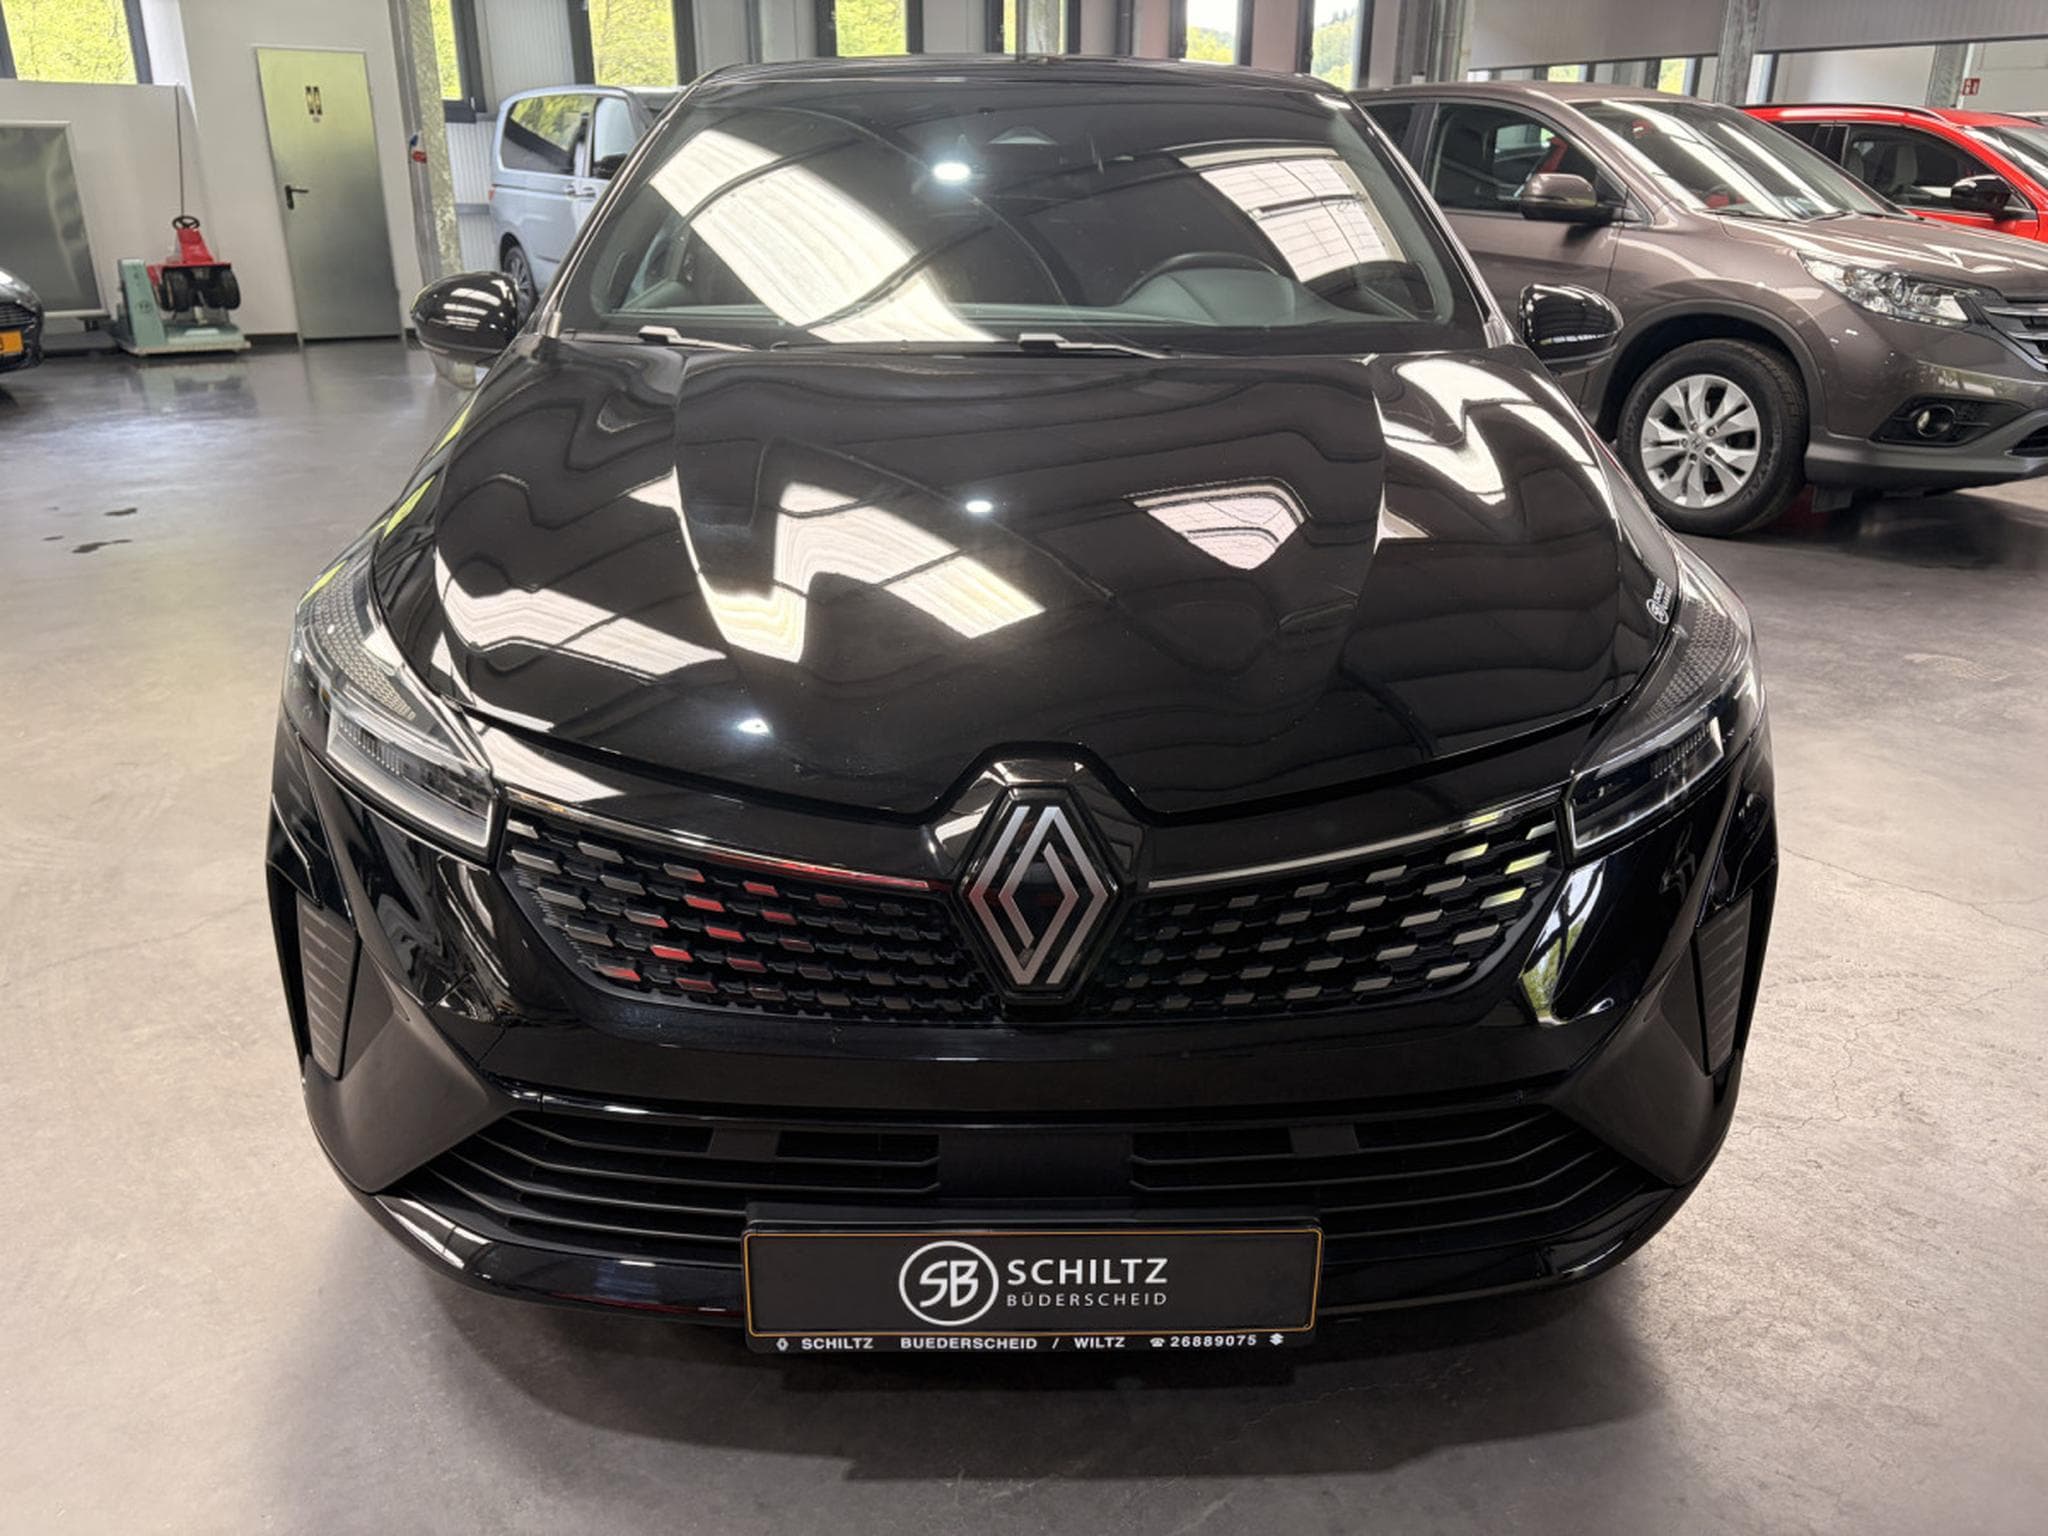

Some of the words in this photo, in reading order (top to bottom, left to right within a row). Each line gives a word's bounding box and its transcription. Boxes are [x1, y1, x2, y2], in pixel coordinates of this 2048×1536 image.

[1006, 1257, 1169, 1286] SCHILTZ
[918, 1259, 980, 1309] SB
[1006, 1291, 1168, 1307] BÜDERSCHEID
[800, 1337, 874, 1350] SCHILTZ
[900, 1336, 1038, 1350] BUEDERSCHEID
[1052, 1337, 1060, 1350] /
[1073, 1336, 1126, 1350] WILTZ
[1170, 1334, 1257, 1348] 26889075
